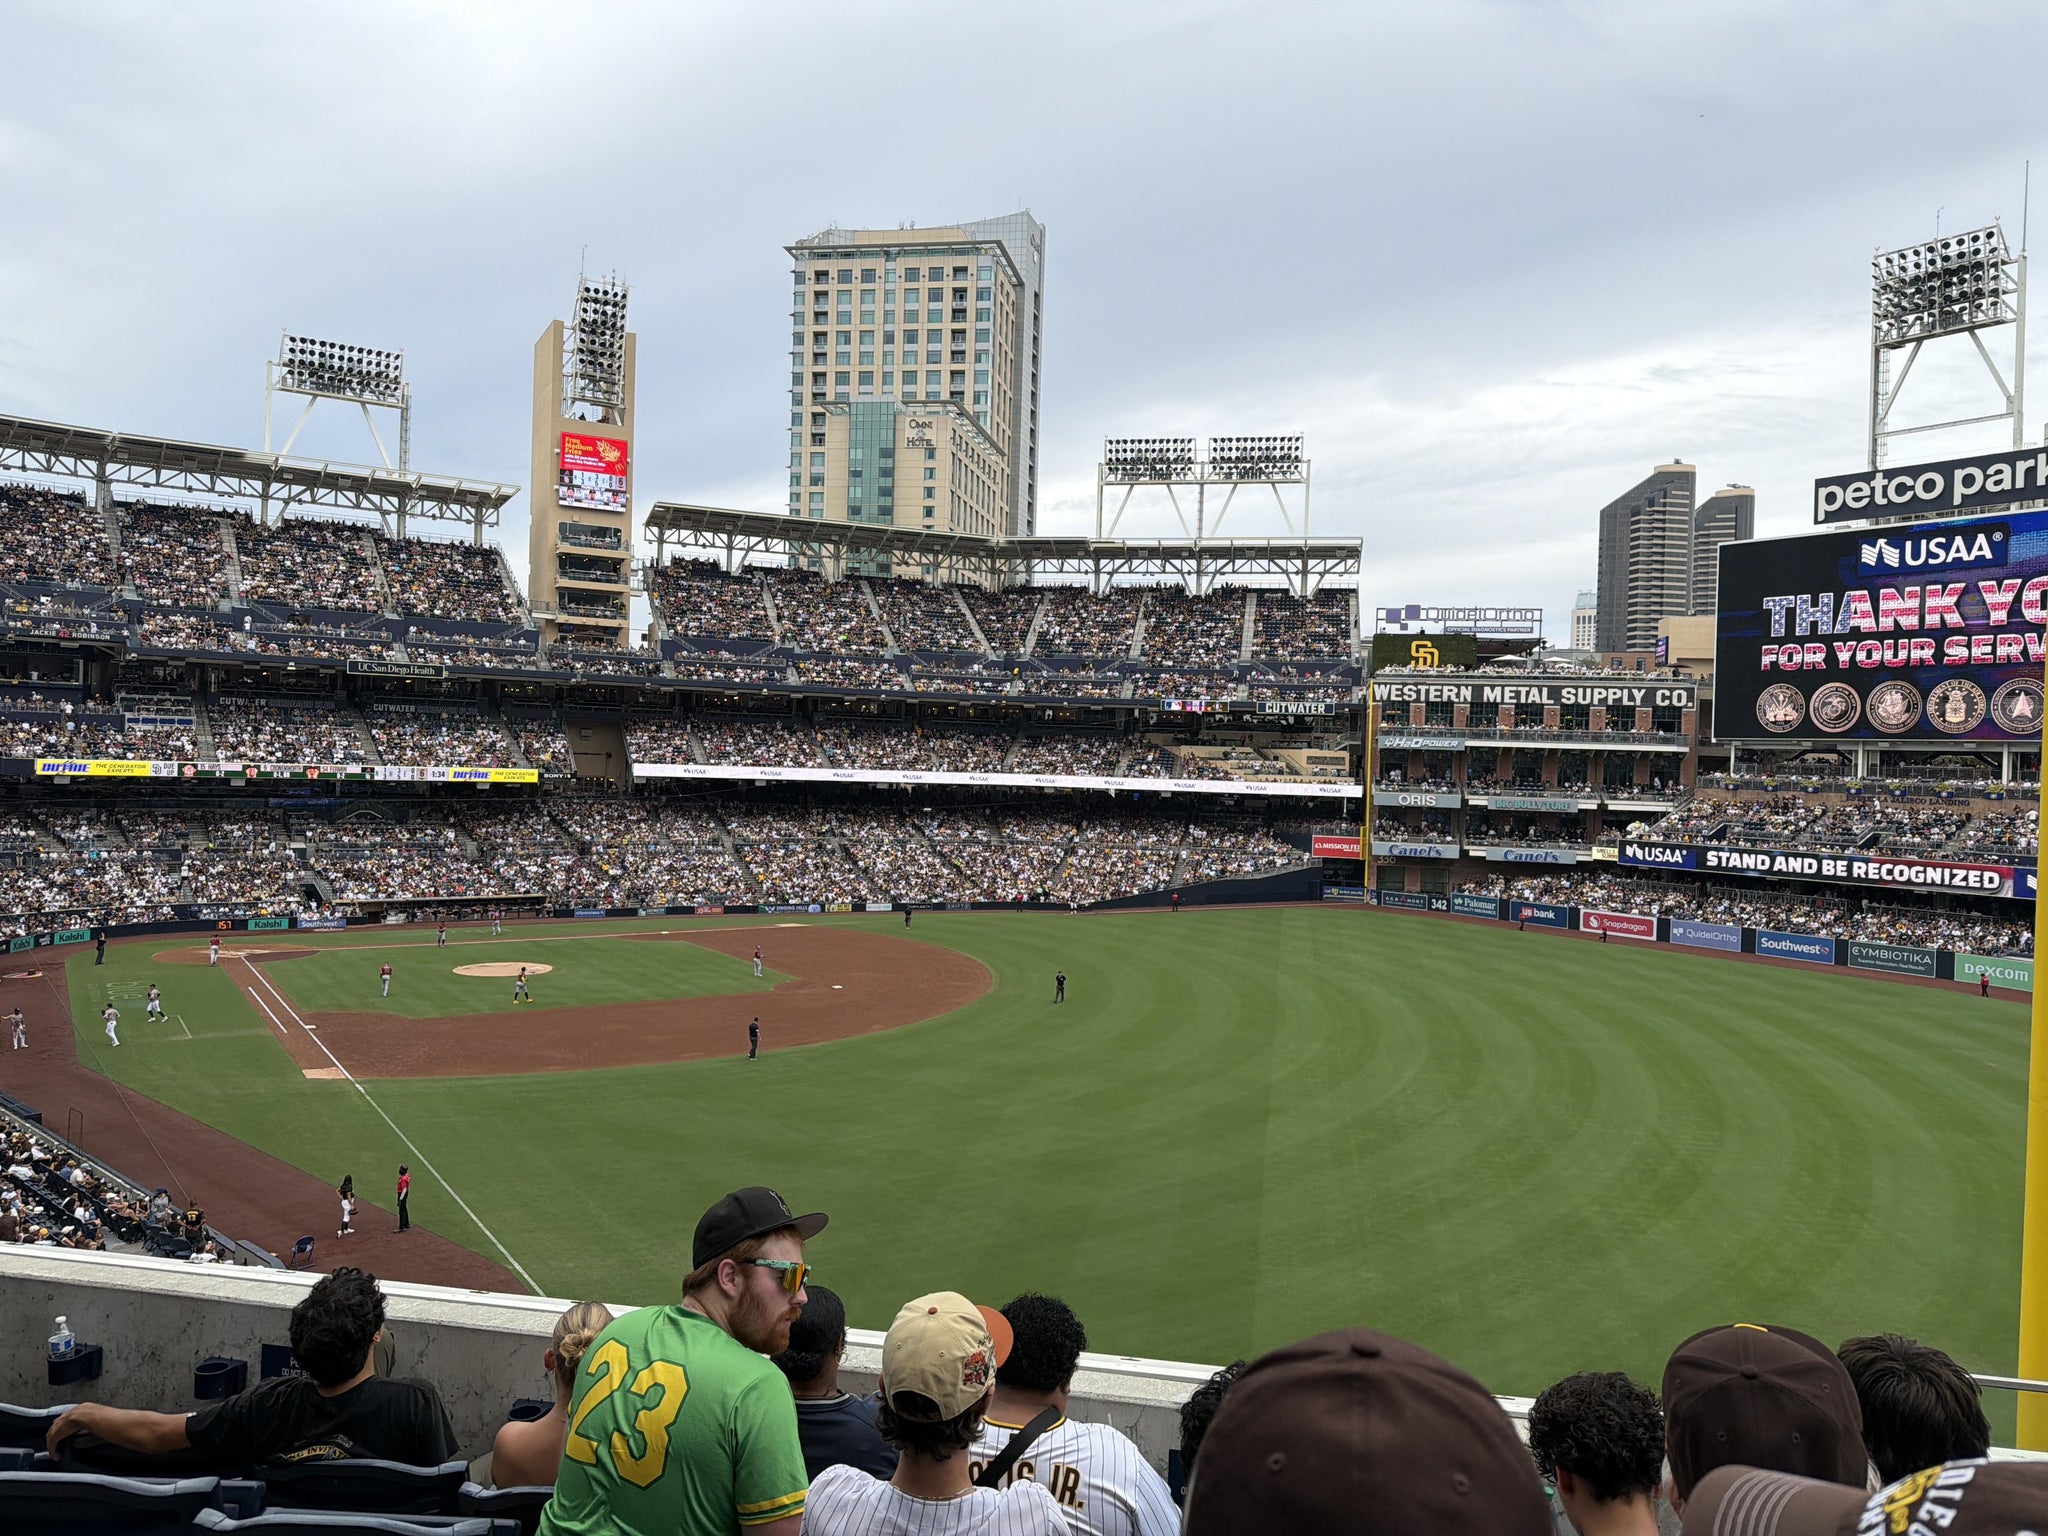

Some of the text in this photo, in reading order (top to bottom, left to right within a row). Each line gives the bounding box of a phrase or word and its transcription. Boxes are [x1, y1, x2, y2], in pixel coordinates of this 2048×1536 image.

[565, 442, 593, 452] Medium
[906, 436, 934, 446] HOTEL
[1817, 472, 1944, 522] petco
[1426, 606, 1534, 623] QuidelOrtho
[1762, 582, 1967, 637] THANK
[72, 632, 110, 640] ROBINSON
[1761, 644, 1827, 671] FOR
[1833, 637, 1936, 670] YOUR
[358, 663, 435, 675] UC San Diego Health
[1374, 684, 1693, 707] WESTERN METAL SUPPLY CO.
[373, 704, 416, 712] CUTWATER
[1265, 703, 1325, 714] CUTWATER
[420, 769, 424, 777] 6
[1398, 795, 1436, 806] ORIS
[1496, 800, 1512, 808] BIG
[1514, 801, 1544, 810] BULLY
[1929, 798, 1970, 806] LANDING
[1388, 844, 1442, 858] Canel's
[1503, 850, 1560, 863] Canel's
[1706, 851, 1770, 870] STAND
[1773, 856, 1818, 874] AND
[1822, 858, 1848, 877] BE
[1852, 862, 2000, 889] RECOGNIZED
[1431, 899, 1447, 910] 342
[1465, 898, 1496, 910] Palomar
[1522, 908, 1555, 920] us bank
[254, 921, 282, 929] Kalshi
[1603, 919, 1647, 932] Snapdragon
[59, 932, 85, 942] Kalshi
[1686, 929, 1738, 943] QuidelOrtho
[1761, 938, 1821, 954] Southwest
[1852, 946, 1932, 965] CYMBIOTIKA
[282, 1368, 289, 1376] DO
[290, 1369, 301, 1378] NOT
[565, 1336, 692, 1490] 23
